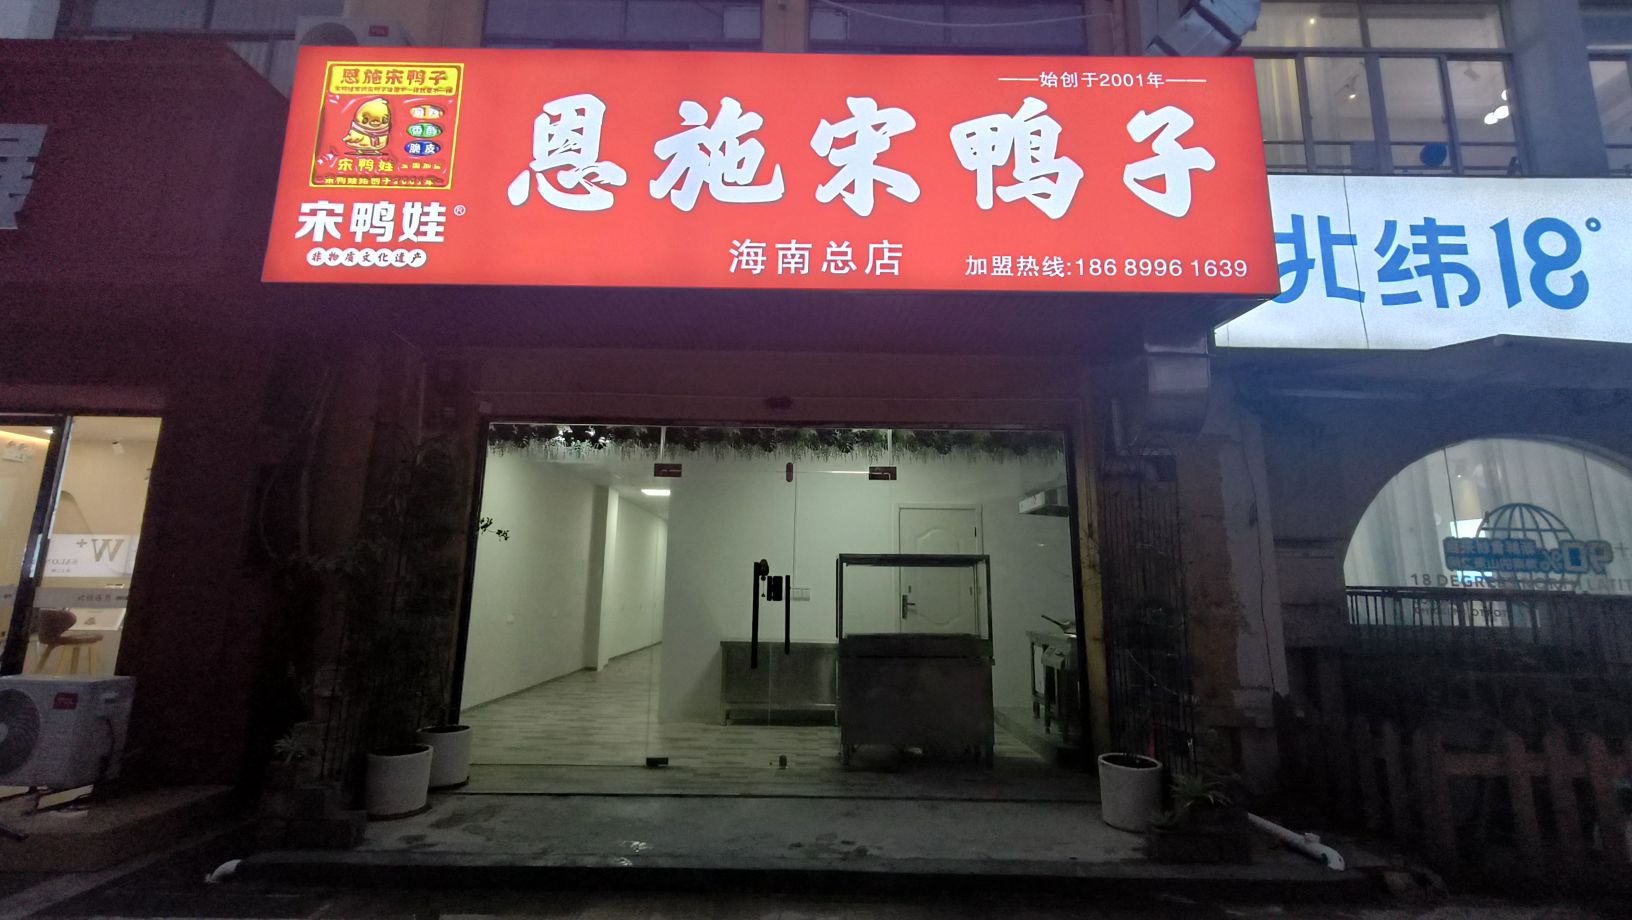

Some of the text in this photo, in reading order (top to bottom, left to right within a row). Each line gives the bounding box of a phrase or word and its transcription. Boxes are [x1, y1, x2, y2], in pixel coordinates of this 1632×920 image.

[341, 68, 447, 85] 恩施宋鸭子
[337, 158, 394, 172] 宋鸭娃
[507, 93, 1216, 220] 恩施宋鸭子
[294, 200, 446, 243] 宋鸭娃
[728, 239, 905, 276] 海南总店
[1124, 258, 1183, 277] 8996
[1191, 259, 1248, 277] 1639
[1411, 573, 1431, 586] 18
